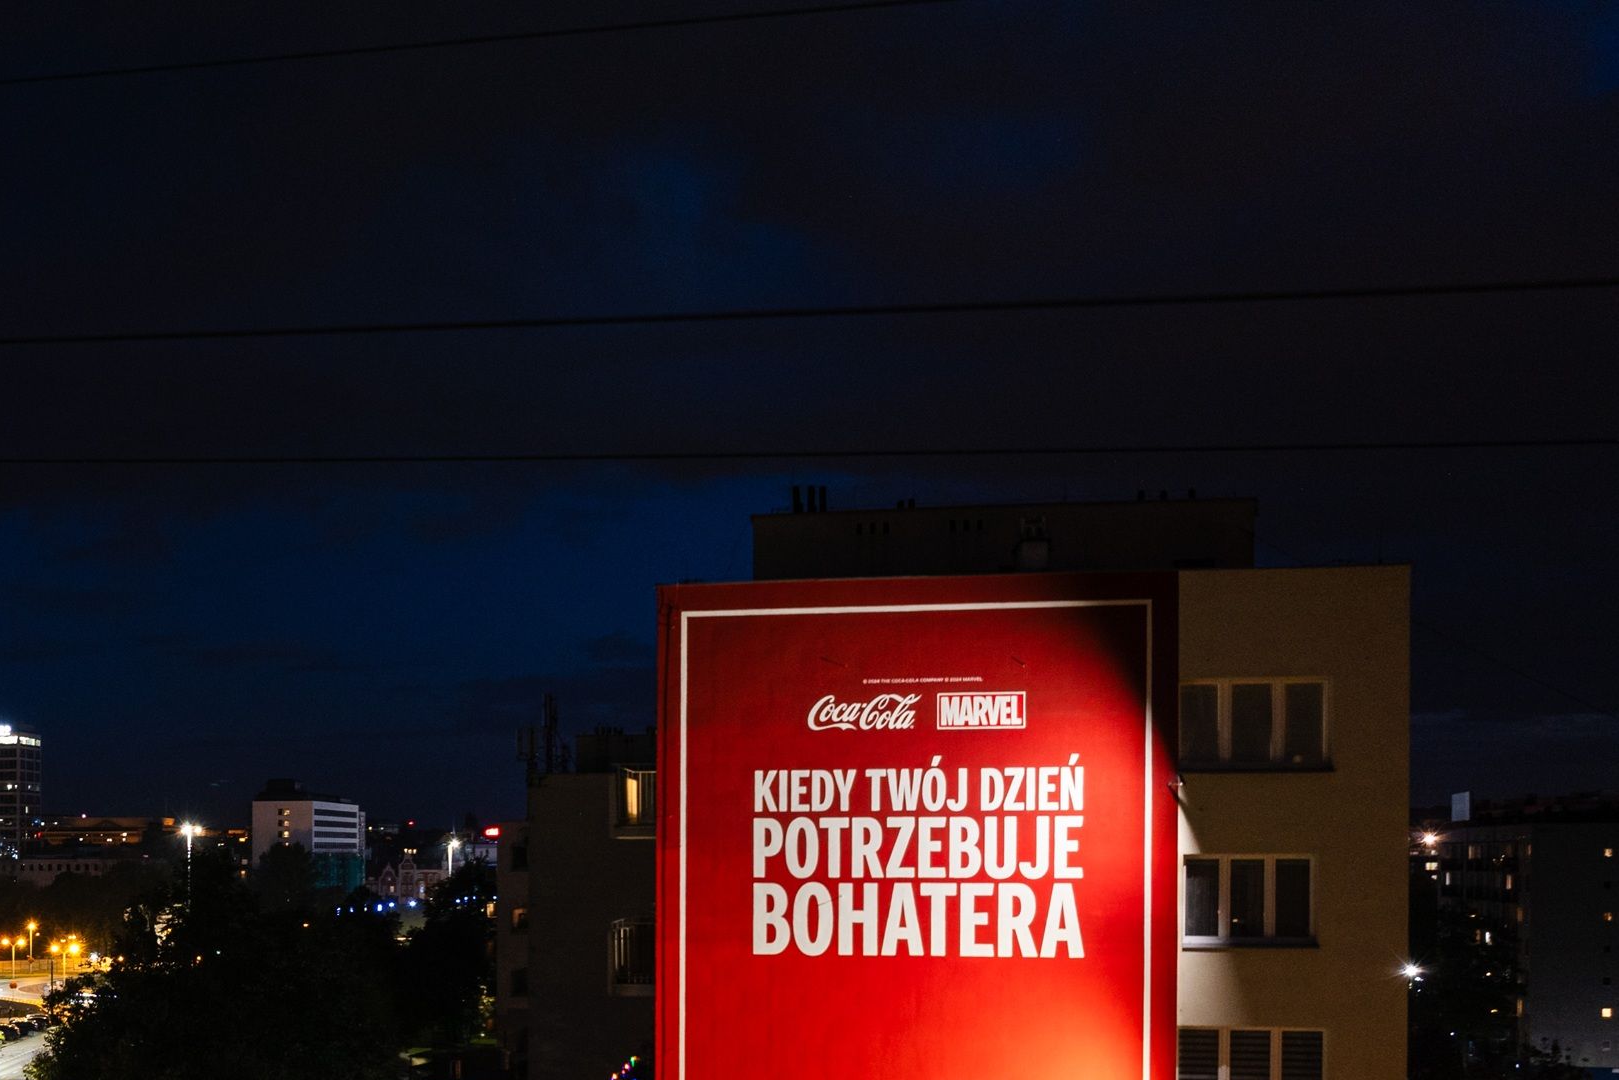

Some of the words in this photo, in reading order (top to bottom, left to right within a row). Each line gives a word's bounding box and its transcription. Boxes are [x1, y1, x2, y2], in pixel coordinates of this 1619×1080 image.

[807, 694, 922, 731] Coca-Cola
[941, 696, 1022, 727] MARVEL
[754, 768, 857, 812] KIEDY
[865, 755, 969, 812] TWÓJ
[980, 753, 1086, 812] DZIEŃ
[753, 815, 1085, 880] POTRZEBUJE
[752, 882, 1085, 959] BOHATERA
